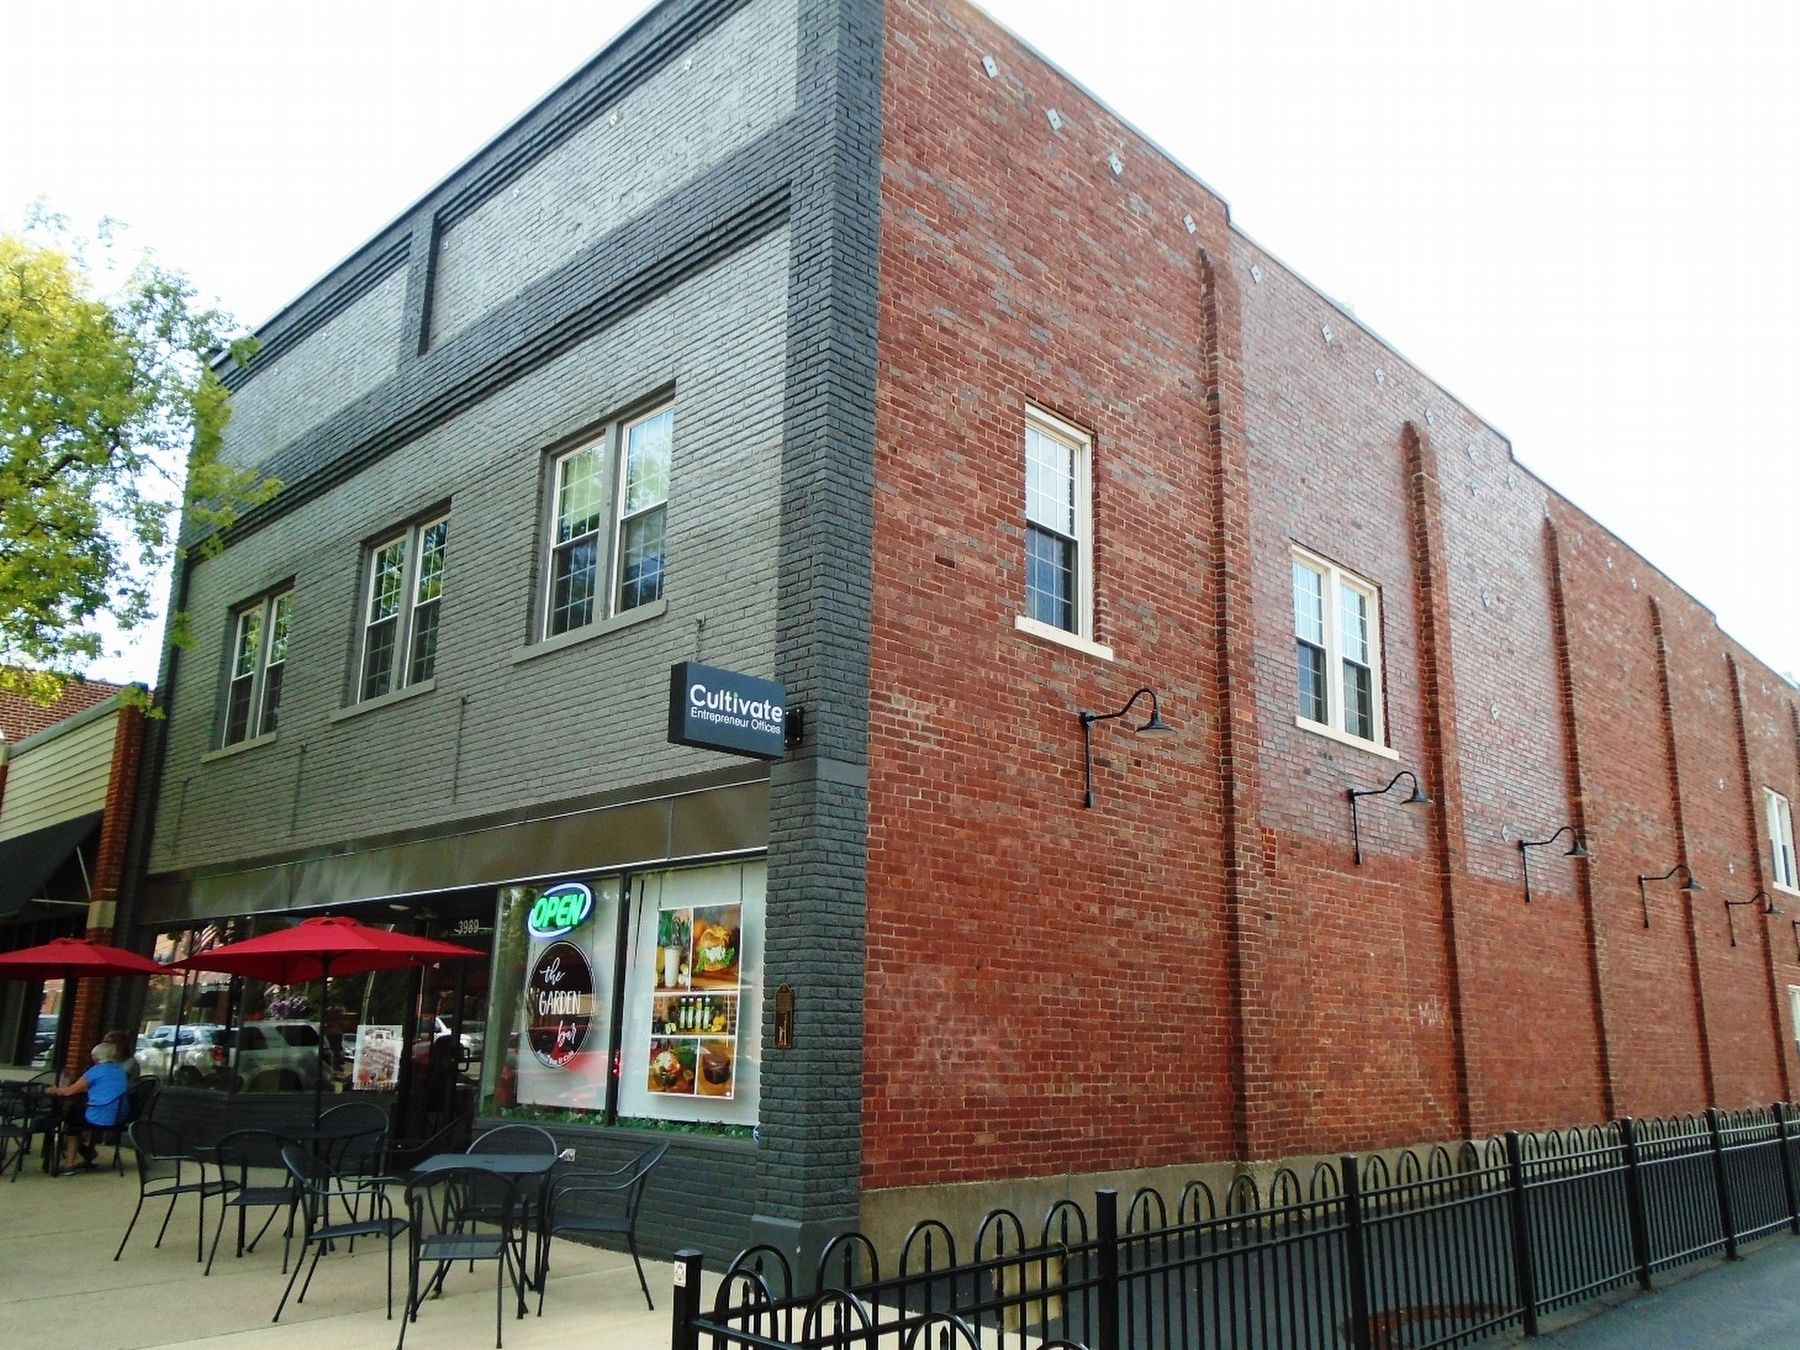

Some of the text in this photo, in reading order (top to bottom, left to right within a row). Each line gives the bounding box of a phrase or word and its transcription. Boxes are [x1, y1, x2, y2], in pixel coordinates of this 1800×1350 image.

[690, 684, 783, 722] Cultivate
[691, 706, 781, 734] Entrepreneur Offices
[532, 893, 585, 928] OPEN
[458, 919, 479, 935] 3989
[539, 957, 566, 985] the
[538, 990, 581, 1016] GARDEN
[557, 1020, 577, 1047] bar
